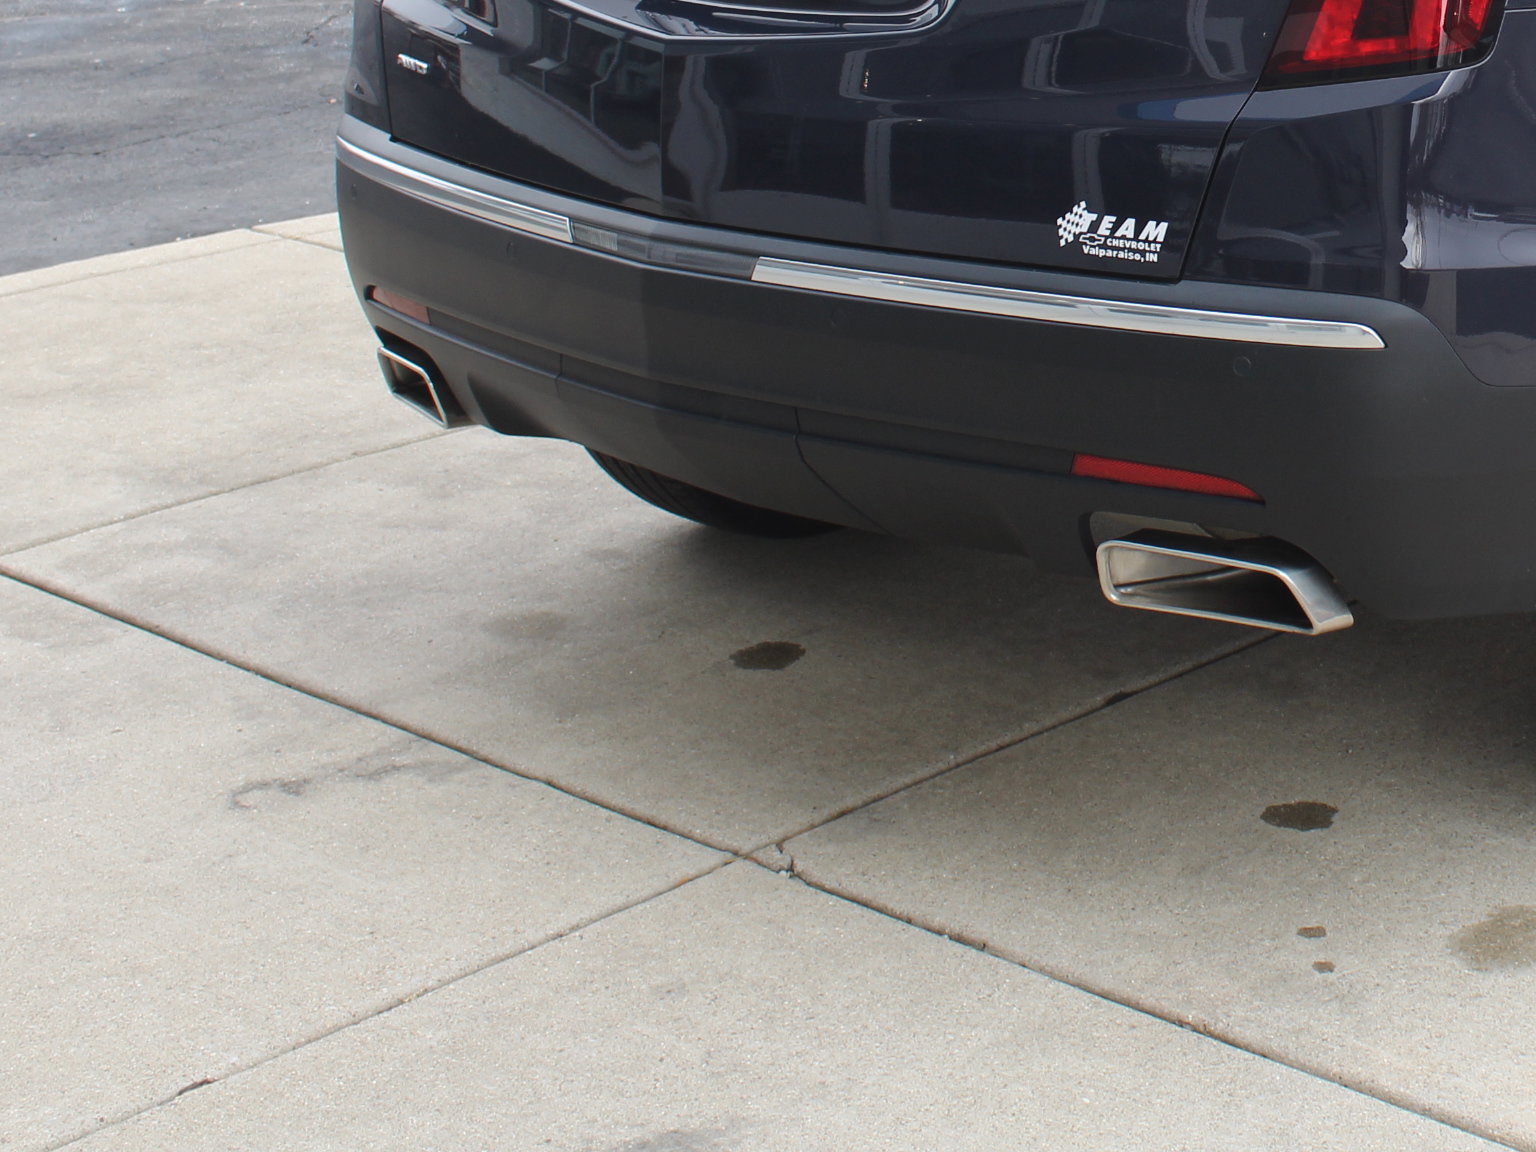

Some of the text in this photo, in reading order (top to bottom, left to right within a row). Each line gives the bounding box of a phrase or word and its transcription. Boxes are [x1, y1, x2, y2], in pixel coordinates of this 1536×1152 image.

[1078, 212, 1169, 242] TEAM
[1082, 245, 1158, 263] Valparaiso, IN
[1106, 238, 1162, 252] CHEVROLET
